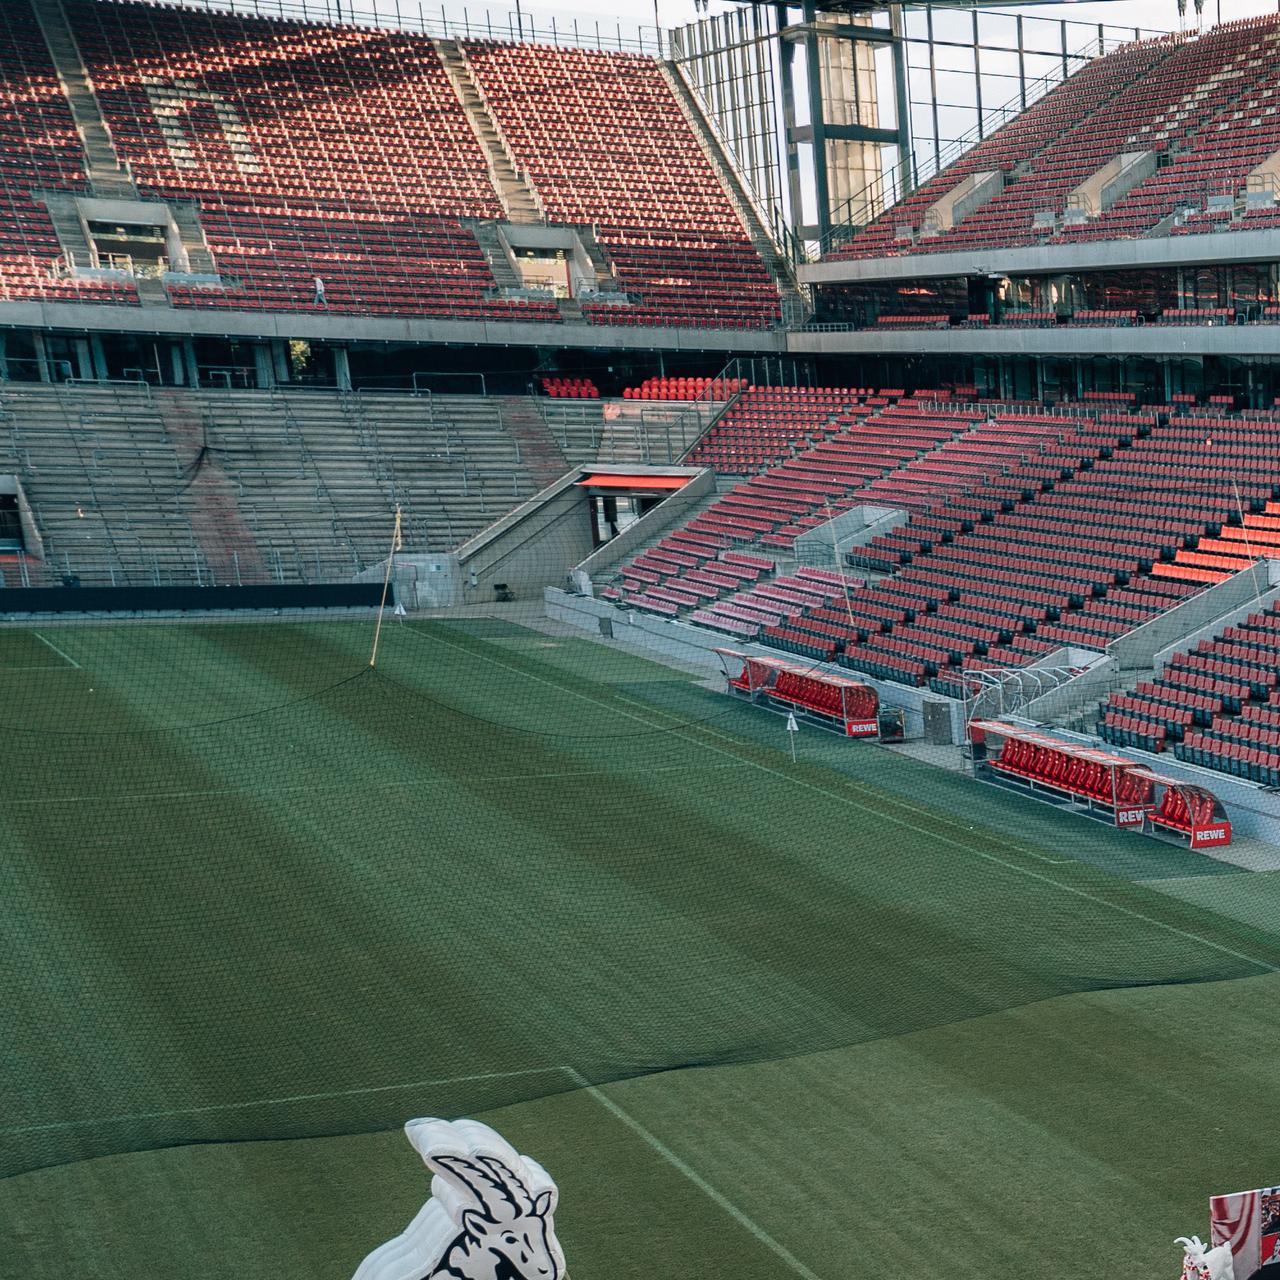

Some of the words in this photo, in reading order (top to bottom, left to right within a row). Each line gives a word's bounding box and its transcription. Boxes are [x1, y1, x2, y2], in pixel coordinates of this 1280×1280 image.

[852, 723, 878, 733] REWE
[1118, 810, 1144, 823] REW
[1196, 829, 1226, 841] REWE
